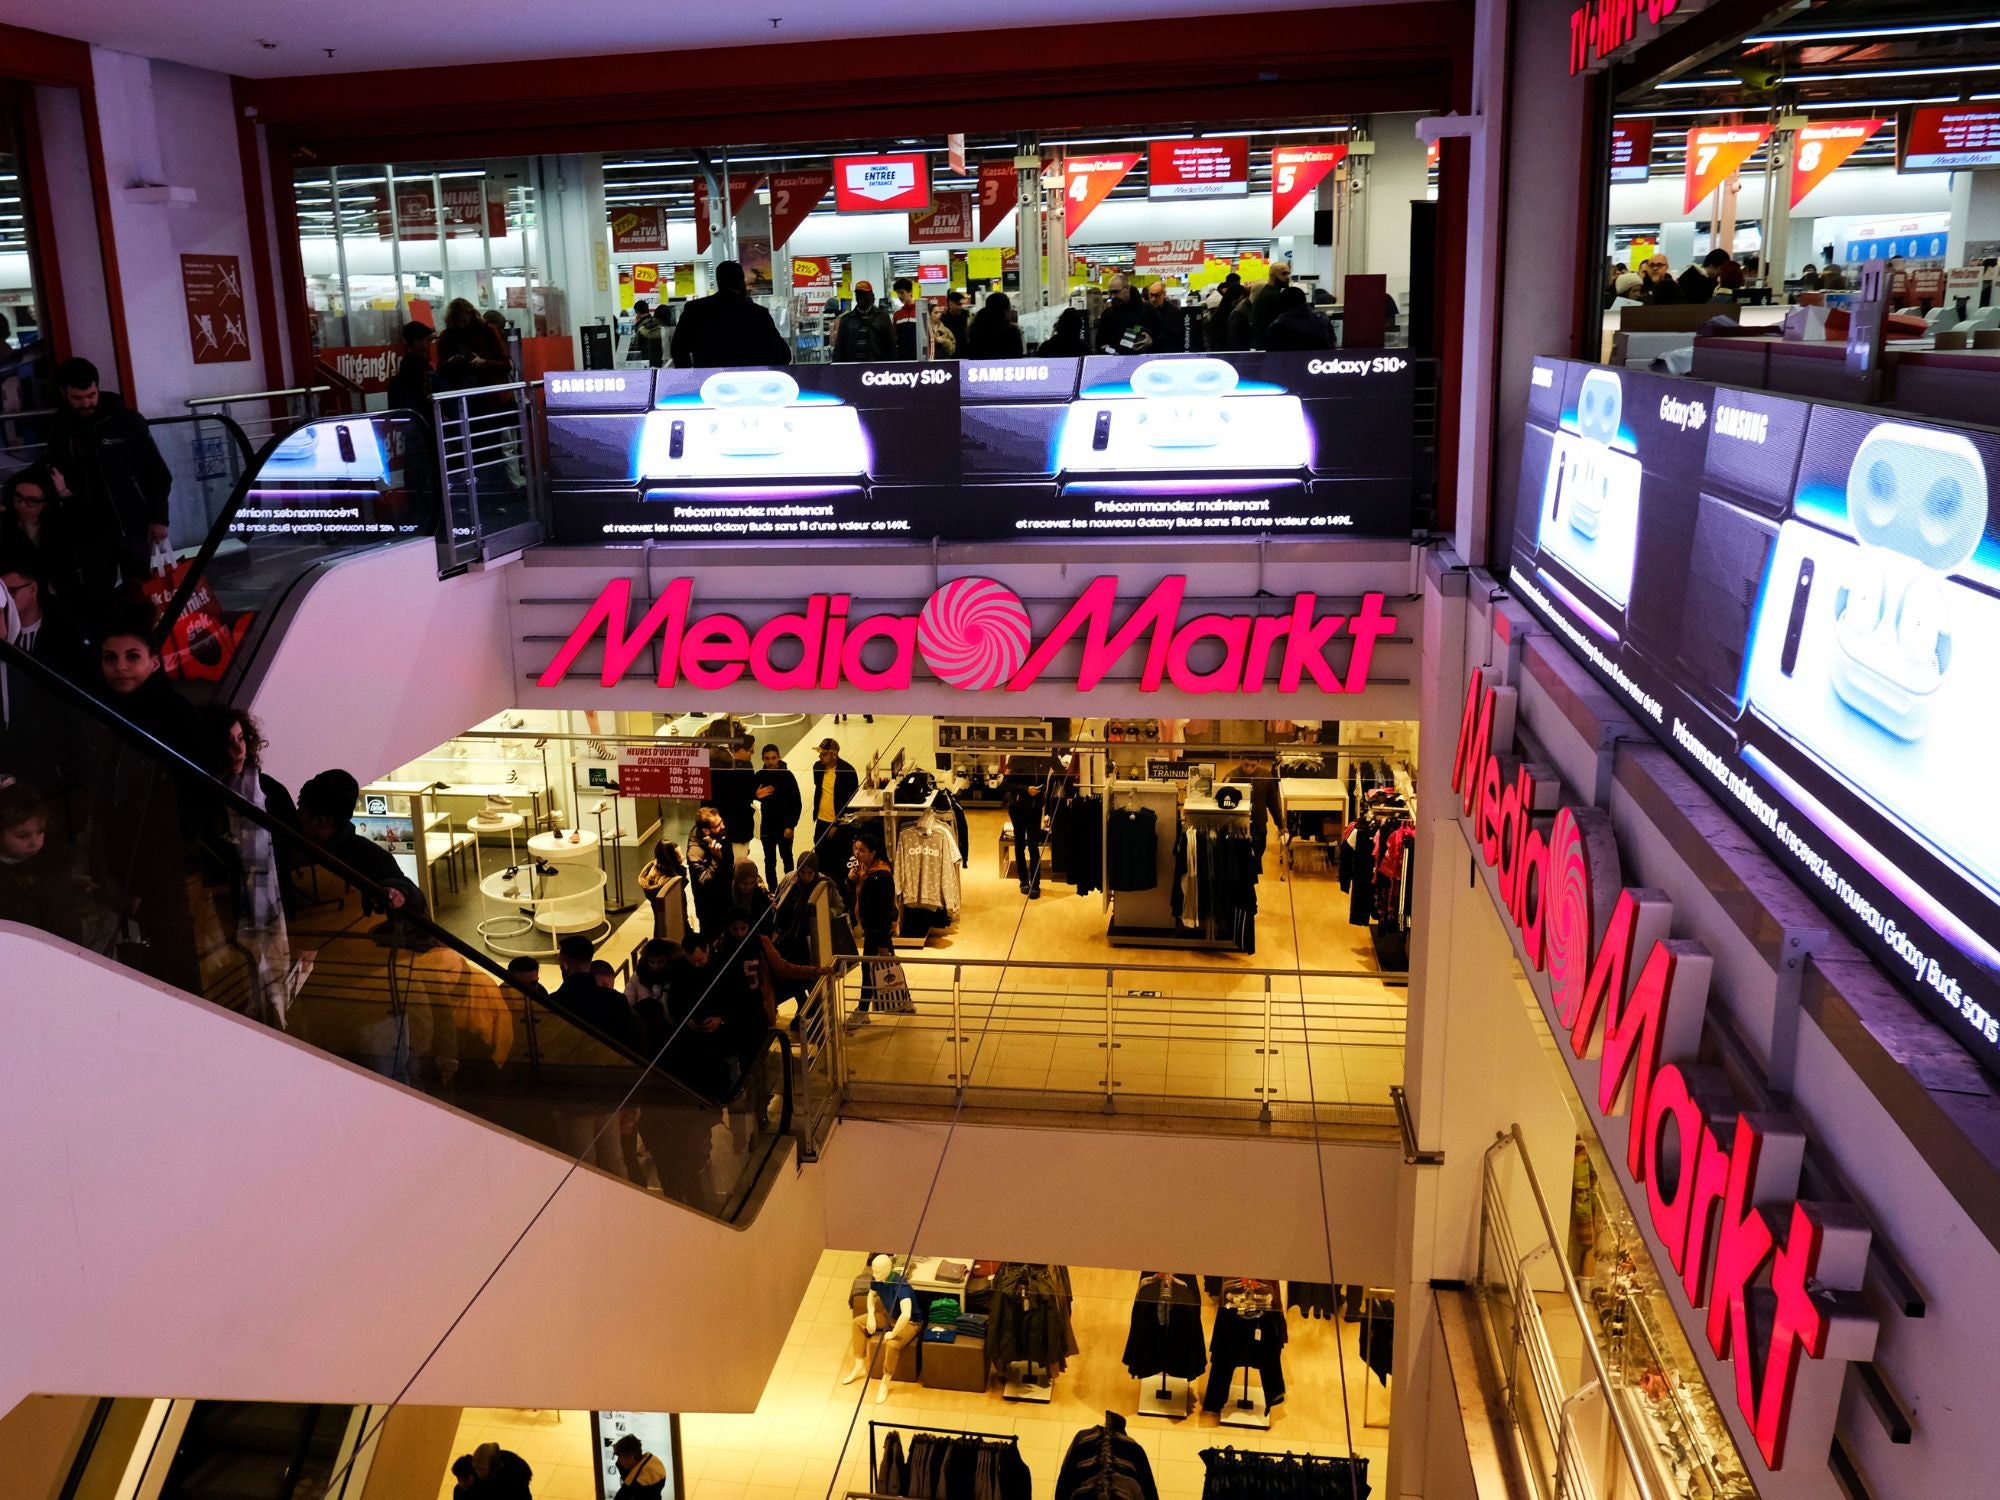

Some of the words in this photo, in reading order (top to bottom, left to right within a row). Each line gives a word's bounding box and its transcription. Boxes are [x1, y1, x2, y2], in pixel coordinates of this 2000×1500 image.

[1695, 147, 1717, 175] 7
[1797, 143, 1822, 171] 8
[983, 167, 1018, 177] Kassa/C
[774, 175, 824, 187] Kassa/Caisse
[1277, 167, 1296, 193] 5
[983, 180, 999, 205] 3
[1069, 176, 1088, 201] 4
[443, 191, 480, 205] NLINE
[775, 191, 790, 215] 2
[465, 205, 481, 218] UP
[933, 214, 960, 226] BTW
[640, 226, 657, 236] TVA
[1157, 251, 1189, 261] cadeau
[336, 350, 403, 384] Uitgang/S
[1308, 359, 1371, 376] Galaxy
[1373, 357, 1407, 372] S10+
[862, 370, 921, 387] Galaxy
[922, 370, 952, 385] S10+
[968, 366, 1048, 382] SAMSUNG
[552, 379, 625, 393] SAMSUNG
[1660, 395, 1689, 431] Galaxy
[1715, 405, 1769, 444] SAMSUNG
[674, 506, 765, 518] Précommandez
[766, 504, 834, 516] maintenant
[1094, 500, 1195, 513] Précommandez
[1196, 498, 1270, 511] maintenant
[603, 524, 614, 533] et
[614, 524, 653, 533] recevez
[655, 523, 669, 532] les
[670, 523, 712, 532] nouveau
[713, 522, 748, 534] Galaxy
[749, 522, 773, 531] Buds
[774, 522, 798, 531] sans
[799, 521, 808, 531] fil
[809, 521, 837, 531] d'une
[838, 521, 870, 530] valeur
[871, 521, 886, 530] de
[1016, 519, 1028, 528] et
[1028, 519, 1071, 528] recevez
[1072, 518, 1087, 528] les
[1089, 518, 1135, 527] nouveau
[1137, 517, 1175, 530] Galaxy
[1176, 517, 1202, 527] Buds
[1204, 517, 1229, 527] sans
[1231, 516, 1241, 526] fil
[1242, 516, 1273, 526] d'une
[1274, 516, 1309, 526] valeur
[1310, 516, 1326, 525] de
[537, 577, 920, 691] Media
[1006, 574, 1396, 693] Markt
[627, 748, 652, 756] HEURES
[653, 748, 699, 757] D'OUVERTURE
[638, 757, 689, 765] OPENINGSUREN
[669, 767, 682, 775] 10h
[689, 777, 704, 785] 20h
[909, 846, 939, 857] addas
[1672, 717, 1730, 786] Précommandez
[1727, 776, 1778, 832] maintenant
[1786, 829, 1823, 877] recevez
[1821, 860, 1838, 890] les
[1836, 878, 1885, 935] nouveau
[1884, 919, 1928, 981] Galaxy
[1927, 958, 1962, 1008] Buds
[1961, 995, 2000, 1042] sans
[1452, 667, 1551, 972] Media
[1571, 887, 1828, 1471] Markt
